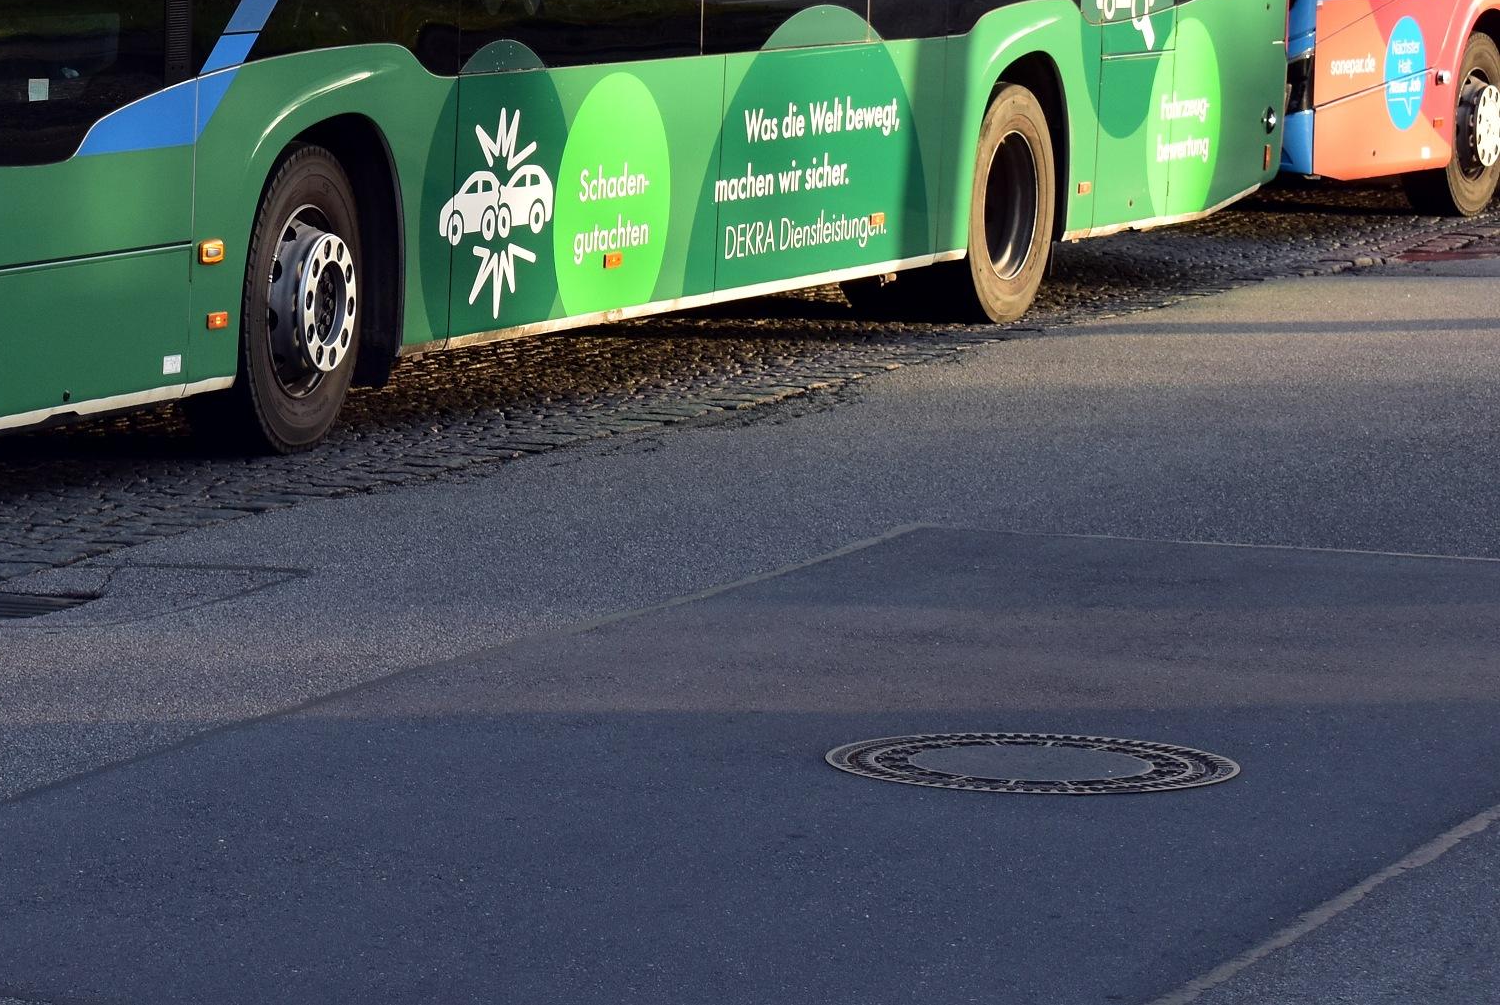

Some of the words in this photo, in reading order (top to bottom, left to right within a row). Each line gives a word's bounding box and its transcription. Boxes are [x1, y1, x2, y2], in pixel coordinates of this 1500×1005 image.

[1330, 52, 1376, 79] sonepar.de
[744, 108, 778, 143] Was
[782, 102, 805, 139] die
[810, 97, 843, 136] Welt
[845, 96, 900, 137] bewegt,
[579, 162, 650, 202] Schaden-
[715, 162, 774, 202] machen
[779, 160, 803, 194] wir
[805, 152, 849, 191] sicher.
[573, 213, 649, 265] gutachten
[724, 220, 776, 260] DEKRA
